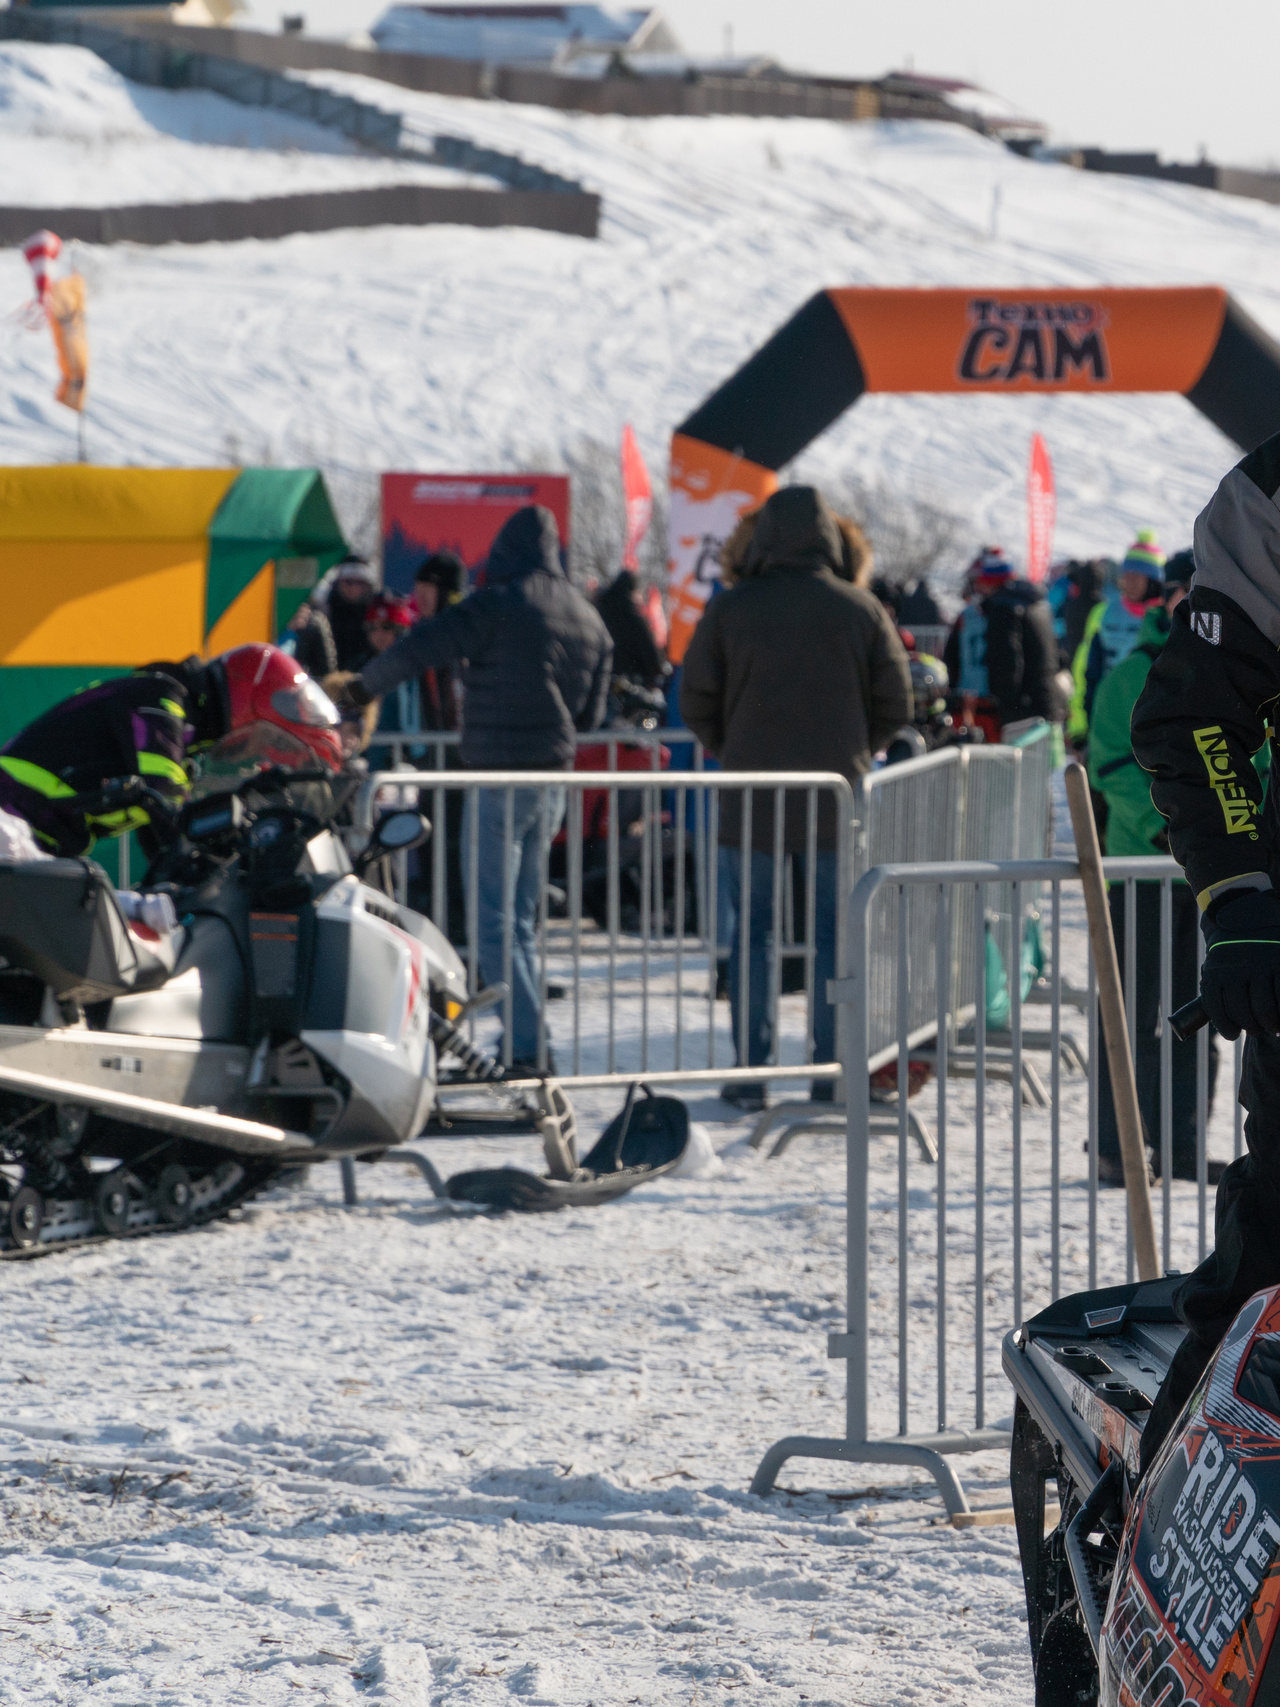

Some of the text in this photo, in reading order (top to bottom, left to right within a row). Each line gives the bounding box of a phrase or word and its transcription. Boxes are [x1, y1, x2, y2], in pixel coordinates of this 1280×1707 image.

[1193, 726, 1257, 834] NOFIN
[1149, 1526, 1236, 1670] STYLE
[1172, 1491, 1248, 1623] RASMUSSEN
